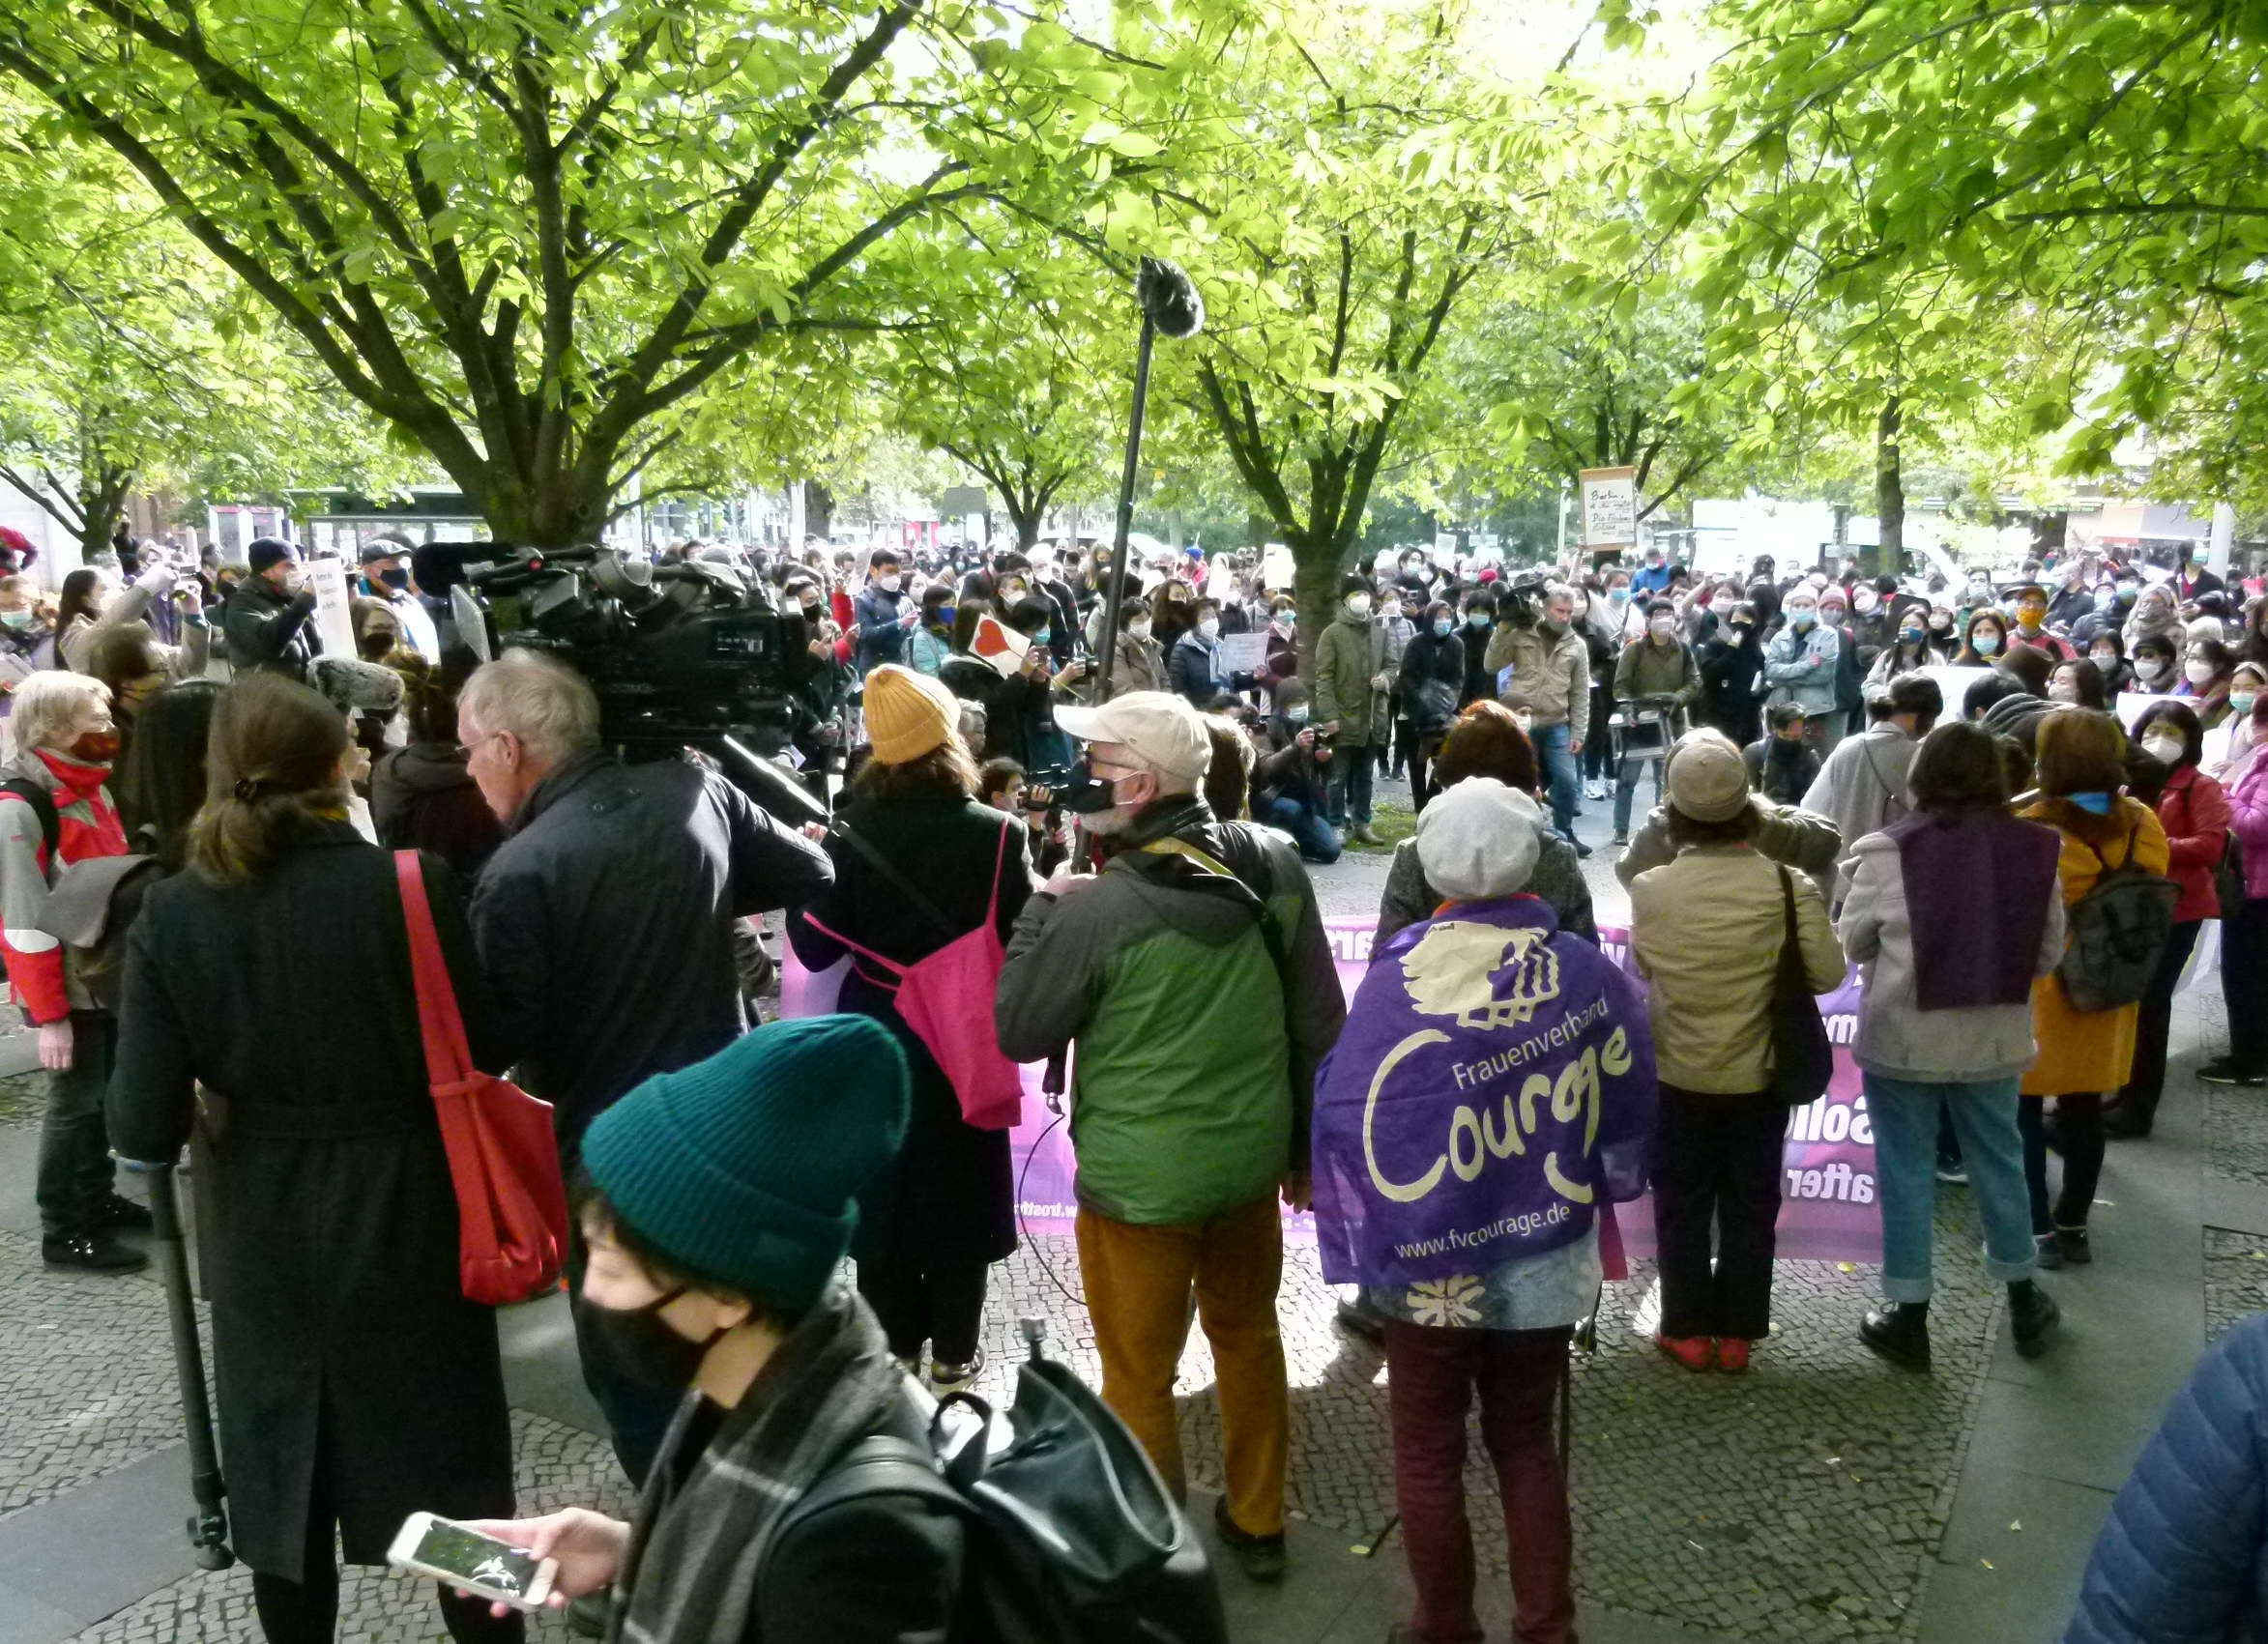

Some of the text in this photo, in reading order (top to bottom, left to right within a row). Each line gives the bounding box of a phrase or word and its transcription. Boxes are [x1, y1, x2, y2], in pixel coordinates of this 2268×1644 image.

[1451, 988, 1610, 1091] Frauenverband
[1363, 1024, 1632, 1203] Courage
[1394, 1201, 1572, 1259] www.fvcourage.de
